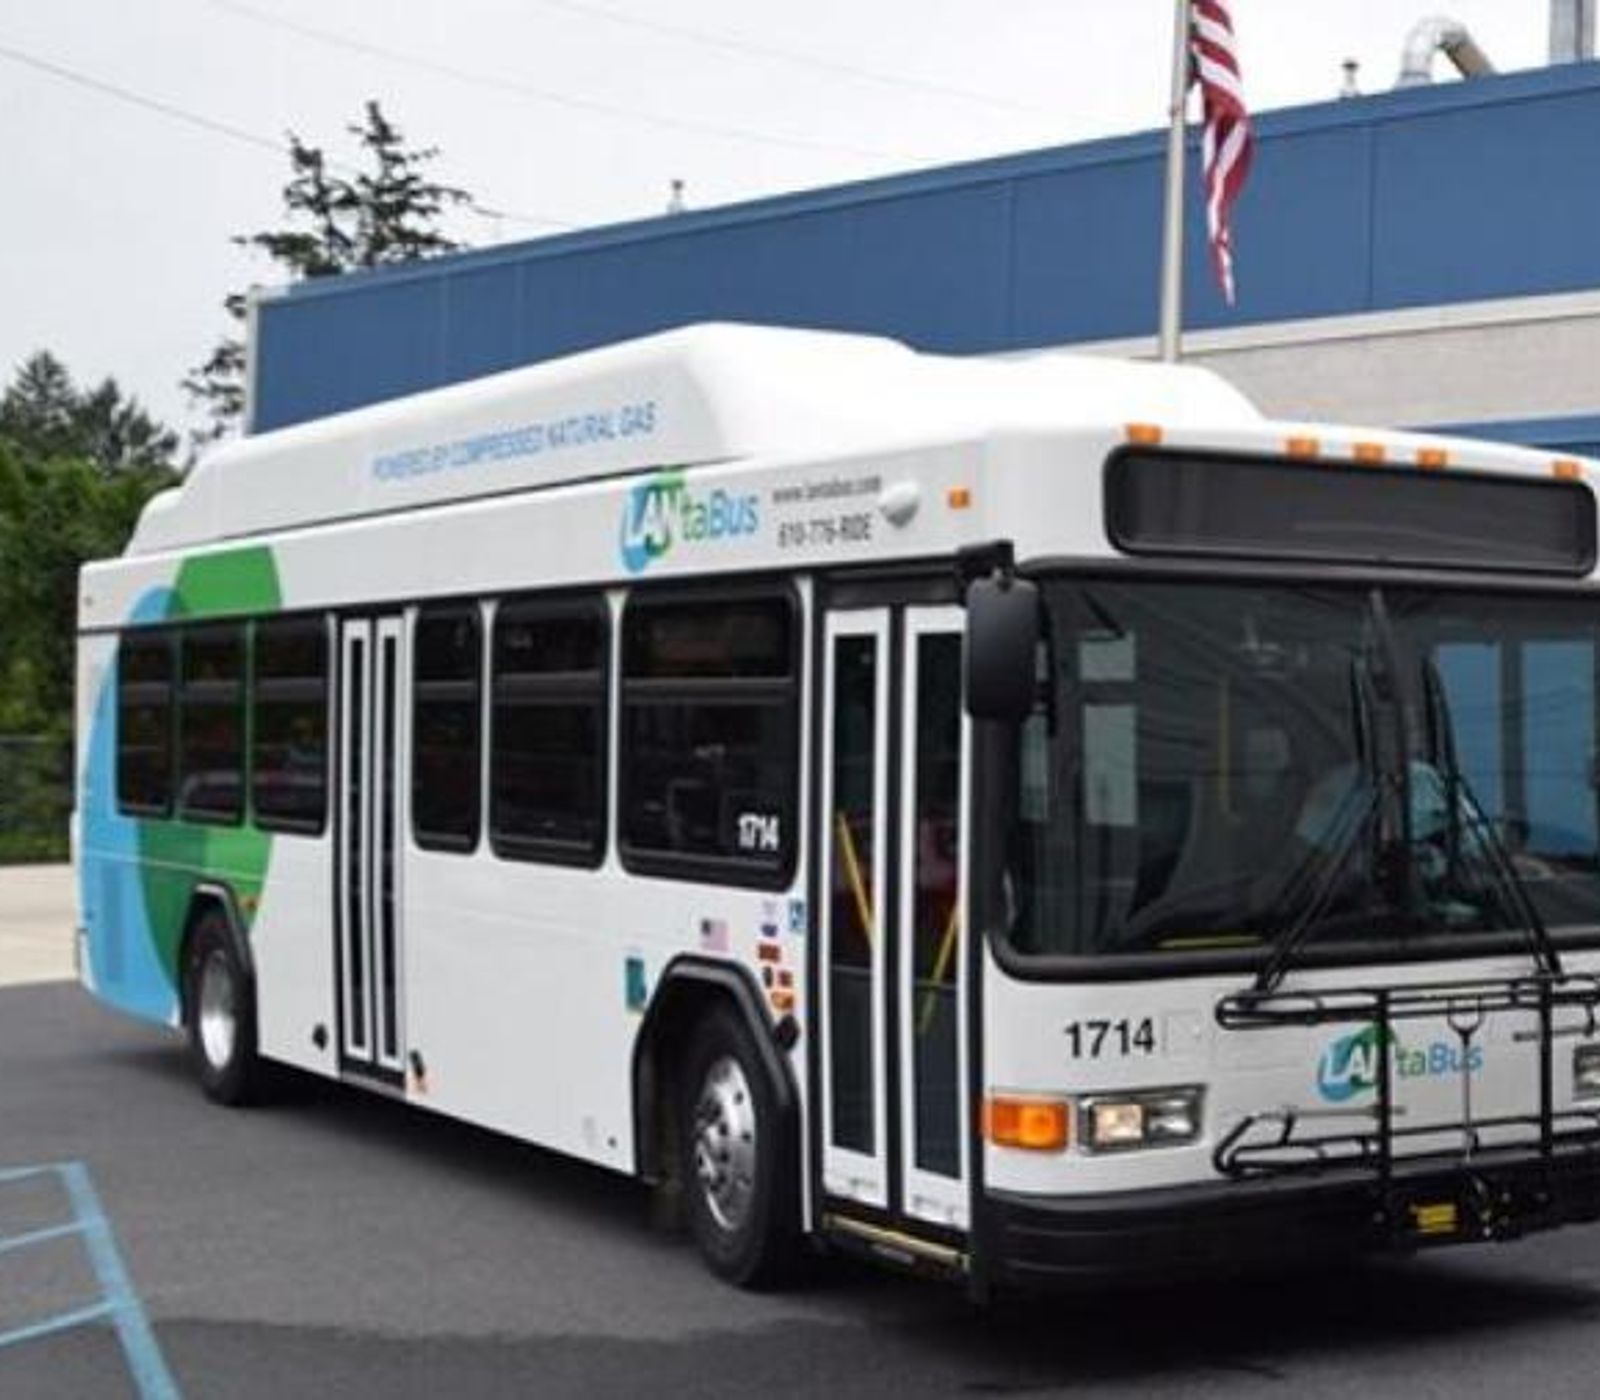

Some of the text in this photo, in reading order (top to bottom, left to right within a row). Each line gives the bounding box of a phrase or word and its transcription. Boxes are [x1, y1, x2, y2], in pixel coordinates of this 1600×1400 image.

[450, 425, 543, 464] COMPRESSED
[547, 413, 615, 447] NATURAL
[620, 401, 655, 435] GAS
[738, 813, 779, 850] 1714
[1065, 1016, 1156, 1058] 1714
